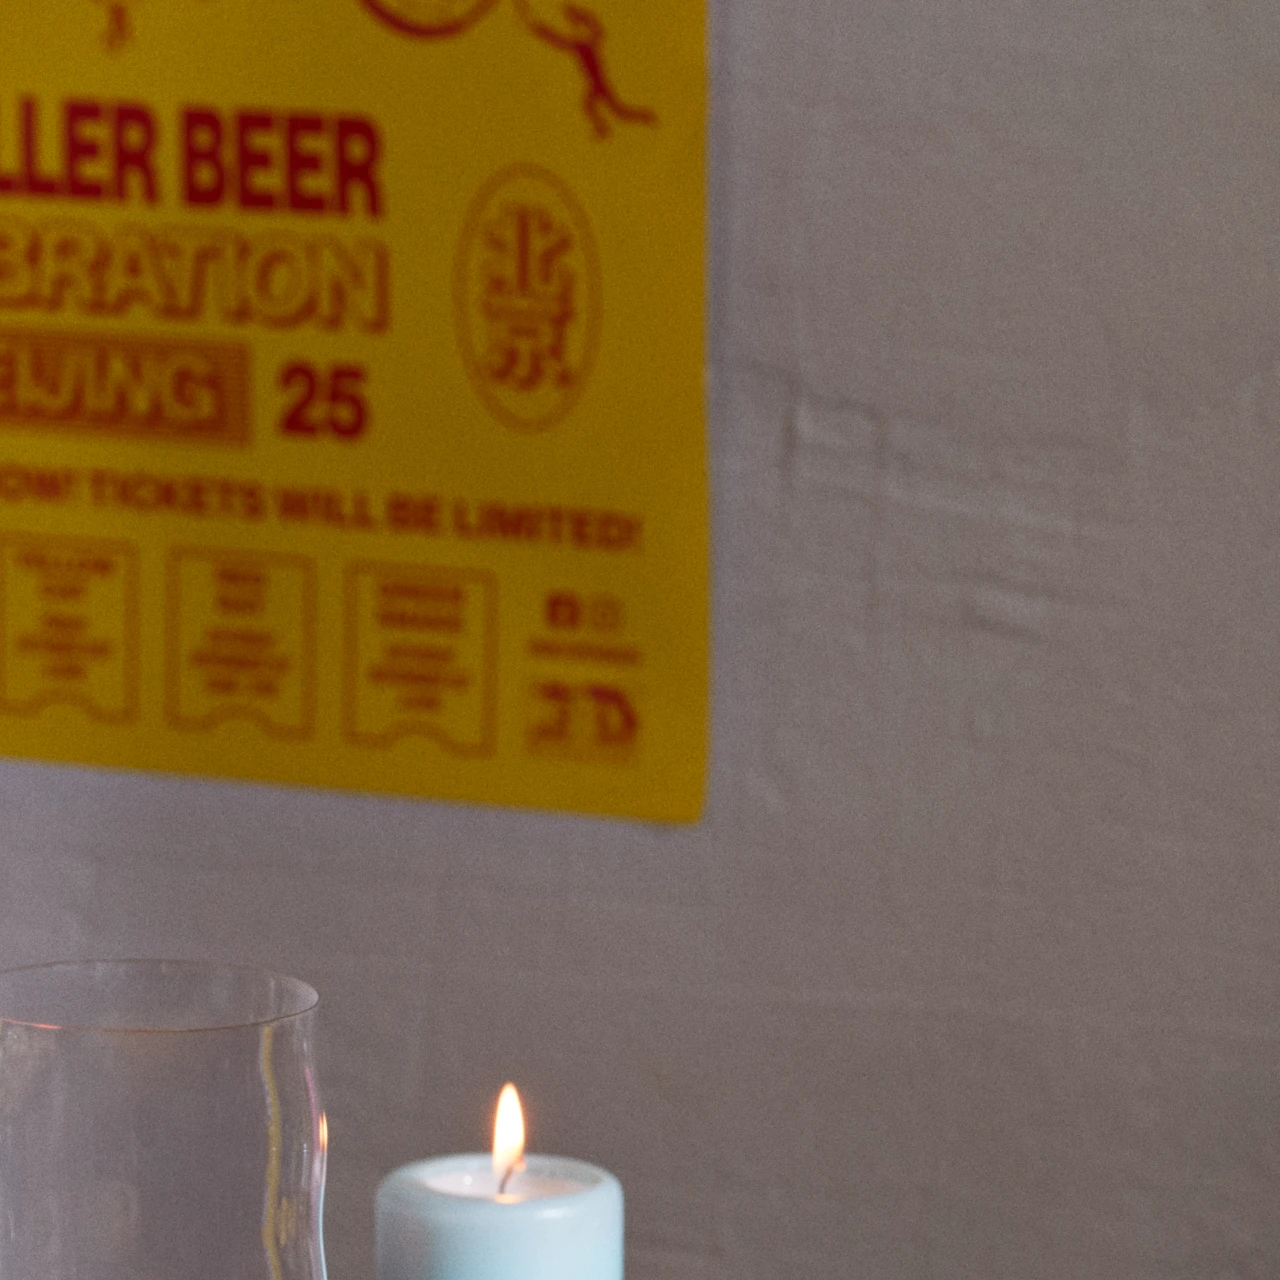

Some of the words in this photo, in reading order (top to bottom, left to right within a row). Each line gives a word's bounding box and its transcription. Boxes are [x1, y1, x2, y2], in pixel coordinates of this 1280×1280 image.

[180, 103, 385, 221] BEER
[277, 359, 371, 440] 25
[89, 468, 267, 521] TICKETS
[275, 487, 377, 532] WILL
[385, 491, 442, 535] BE
